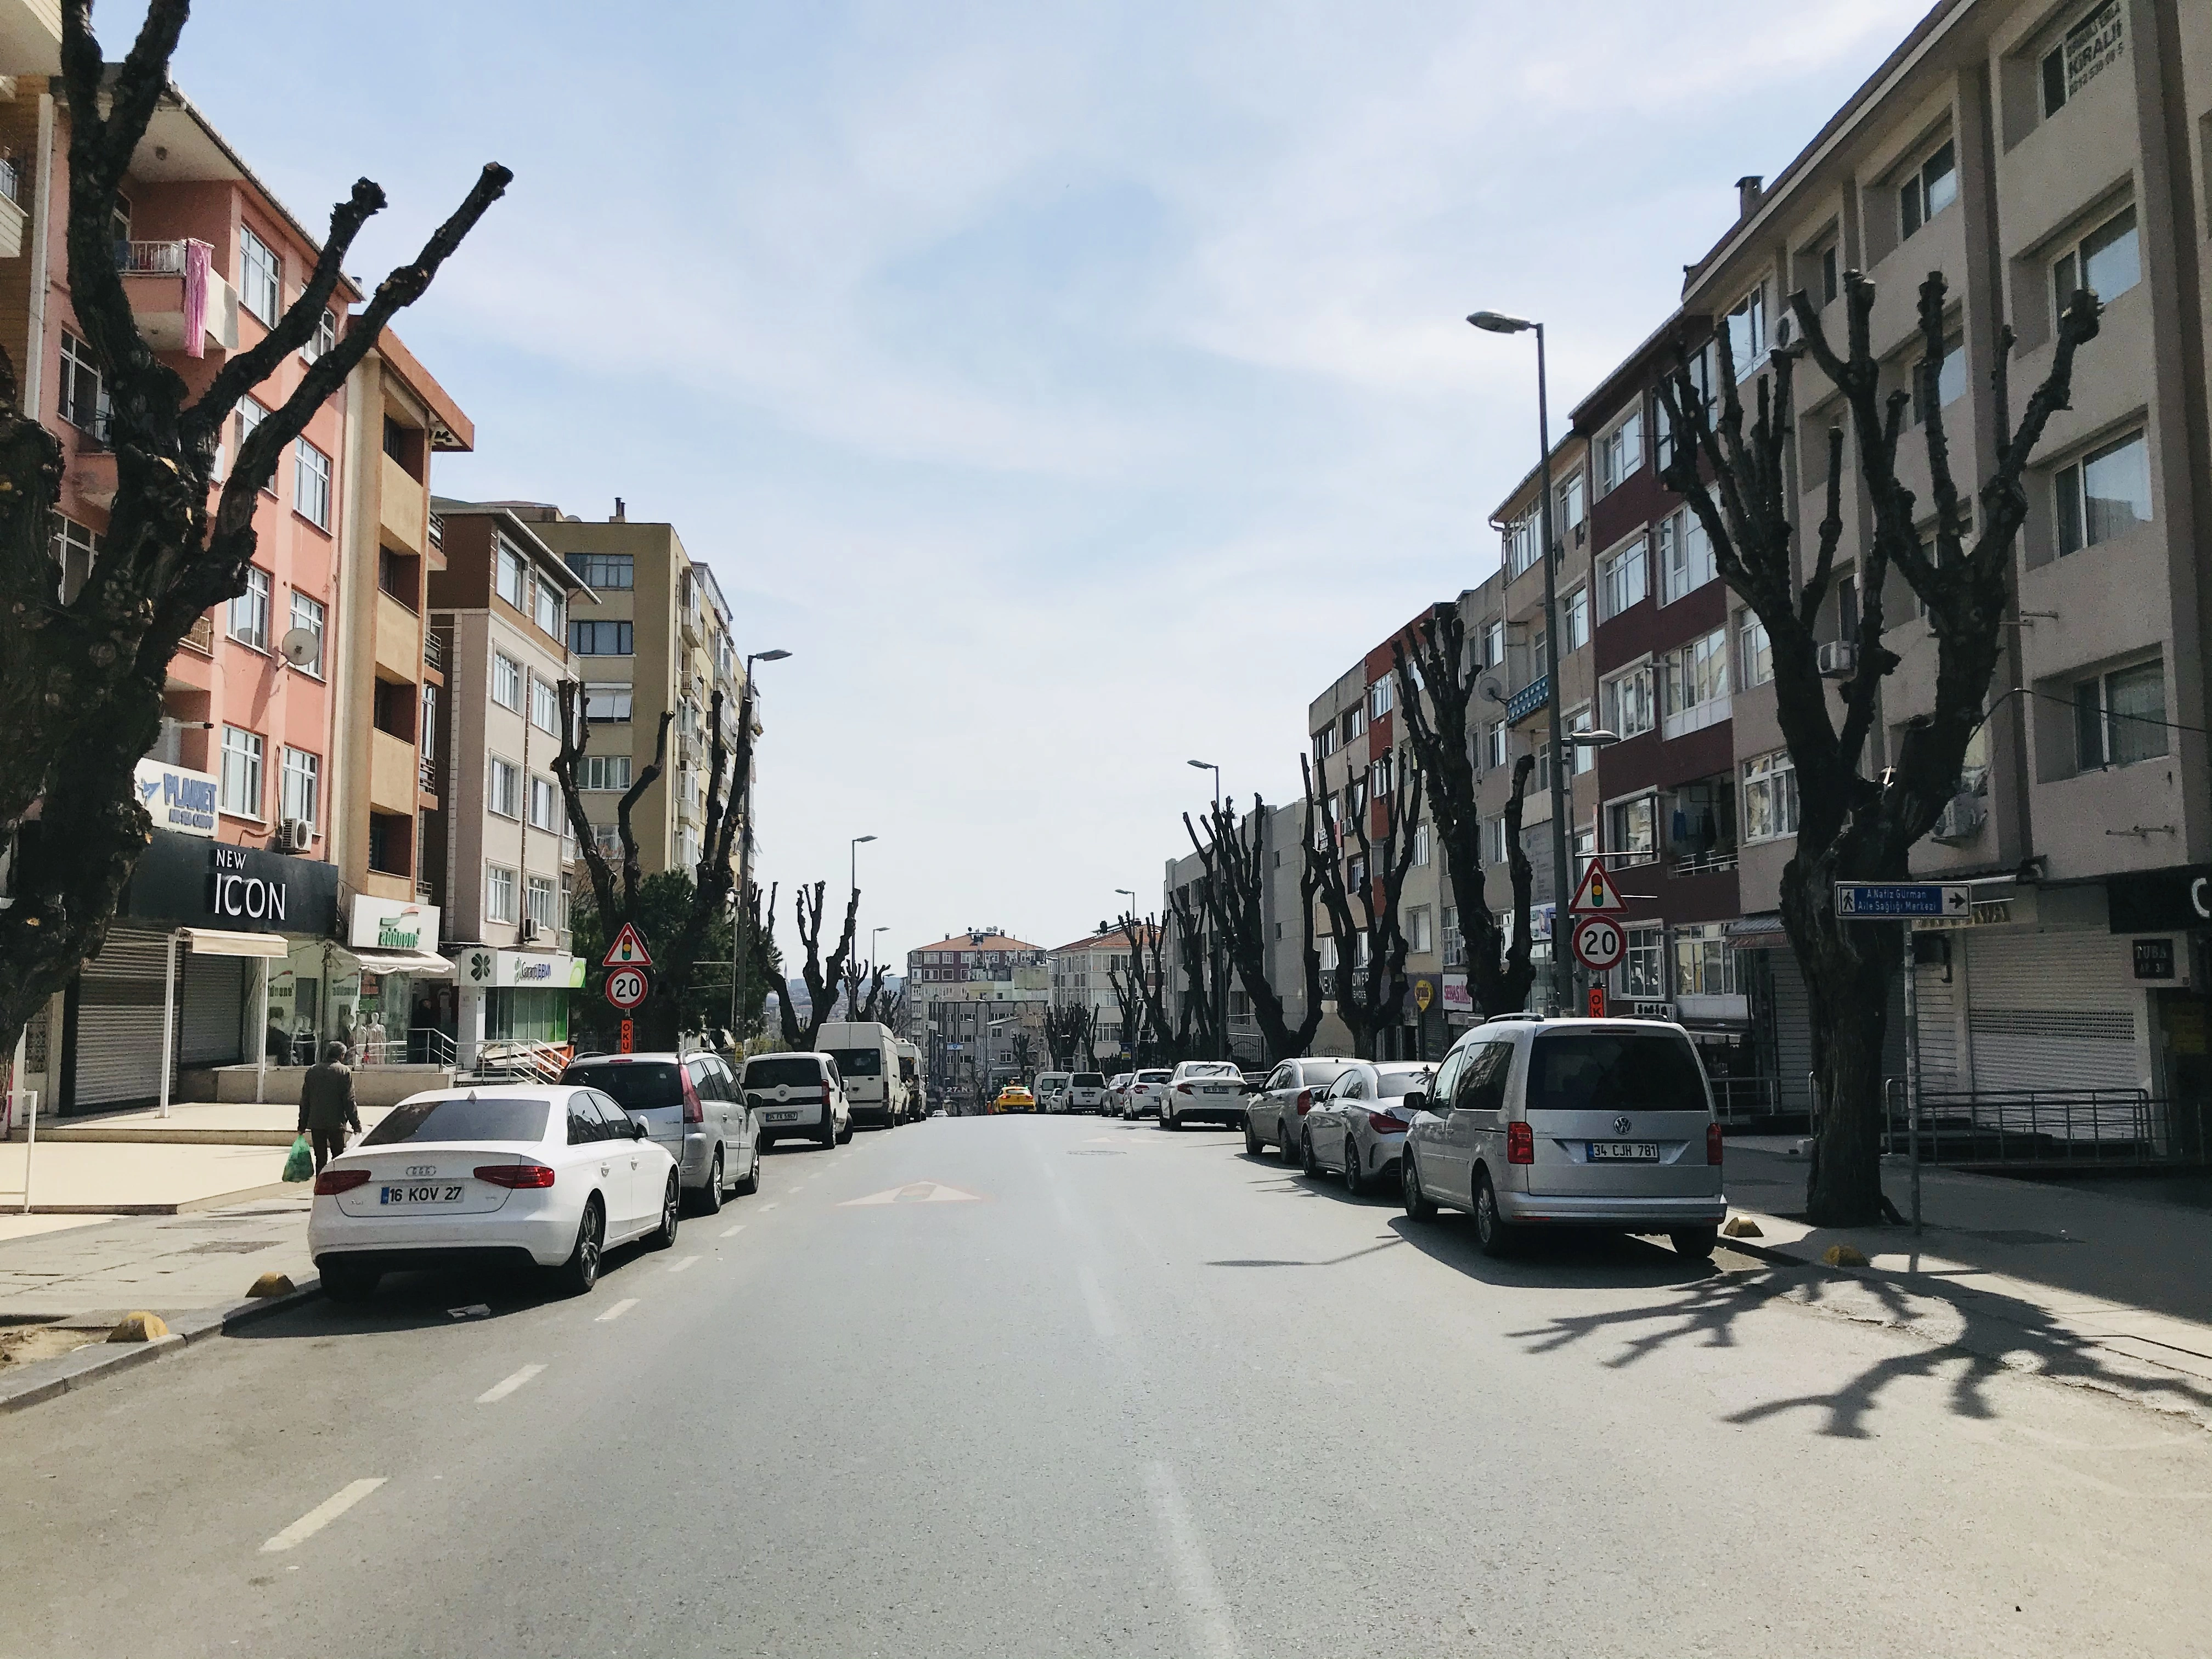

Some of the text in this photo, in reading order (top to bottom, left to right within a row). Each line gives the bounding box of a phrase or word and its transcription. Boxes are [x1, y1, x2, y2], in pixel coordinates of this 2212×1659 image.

[163, 772, 217, 814] PLANET
[216, 849, 246, 870] NEW
[215, 873, 286, 920] ICON
[1905, 901, 1936, 910] Merkezi
[1584, 930, 1616, 955] 20
[616, 978, 640, 997] 20
[1353, 990, 1366, 998] SHOES
[622, 1024, 630, 1054] OKU
[1594, 1145, 1656, 1156] 34 CJH 781
[390, 1187, 462, 1202] 16 KOV 27
